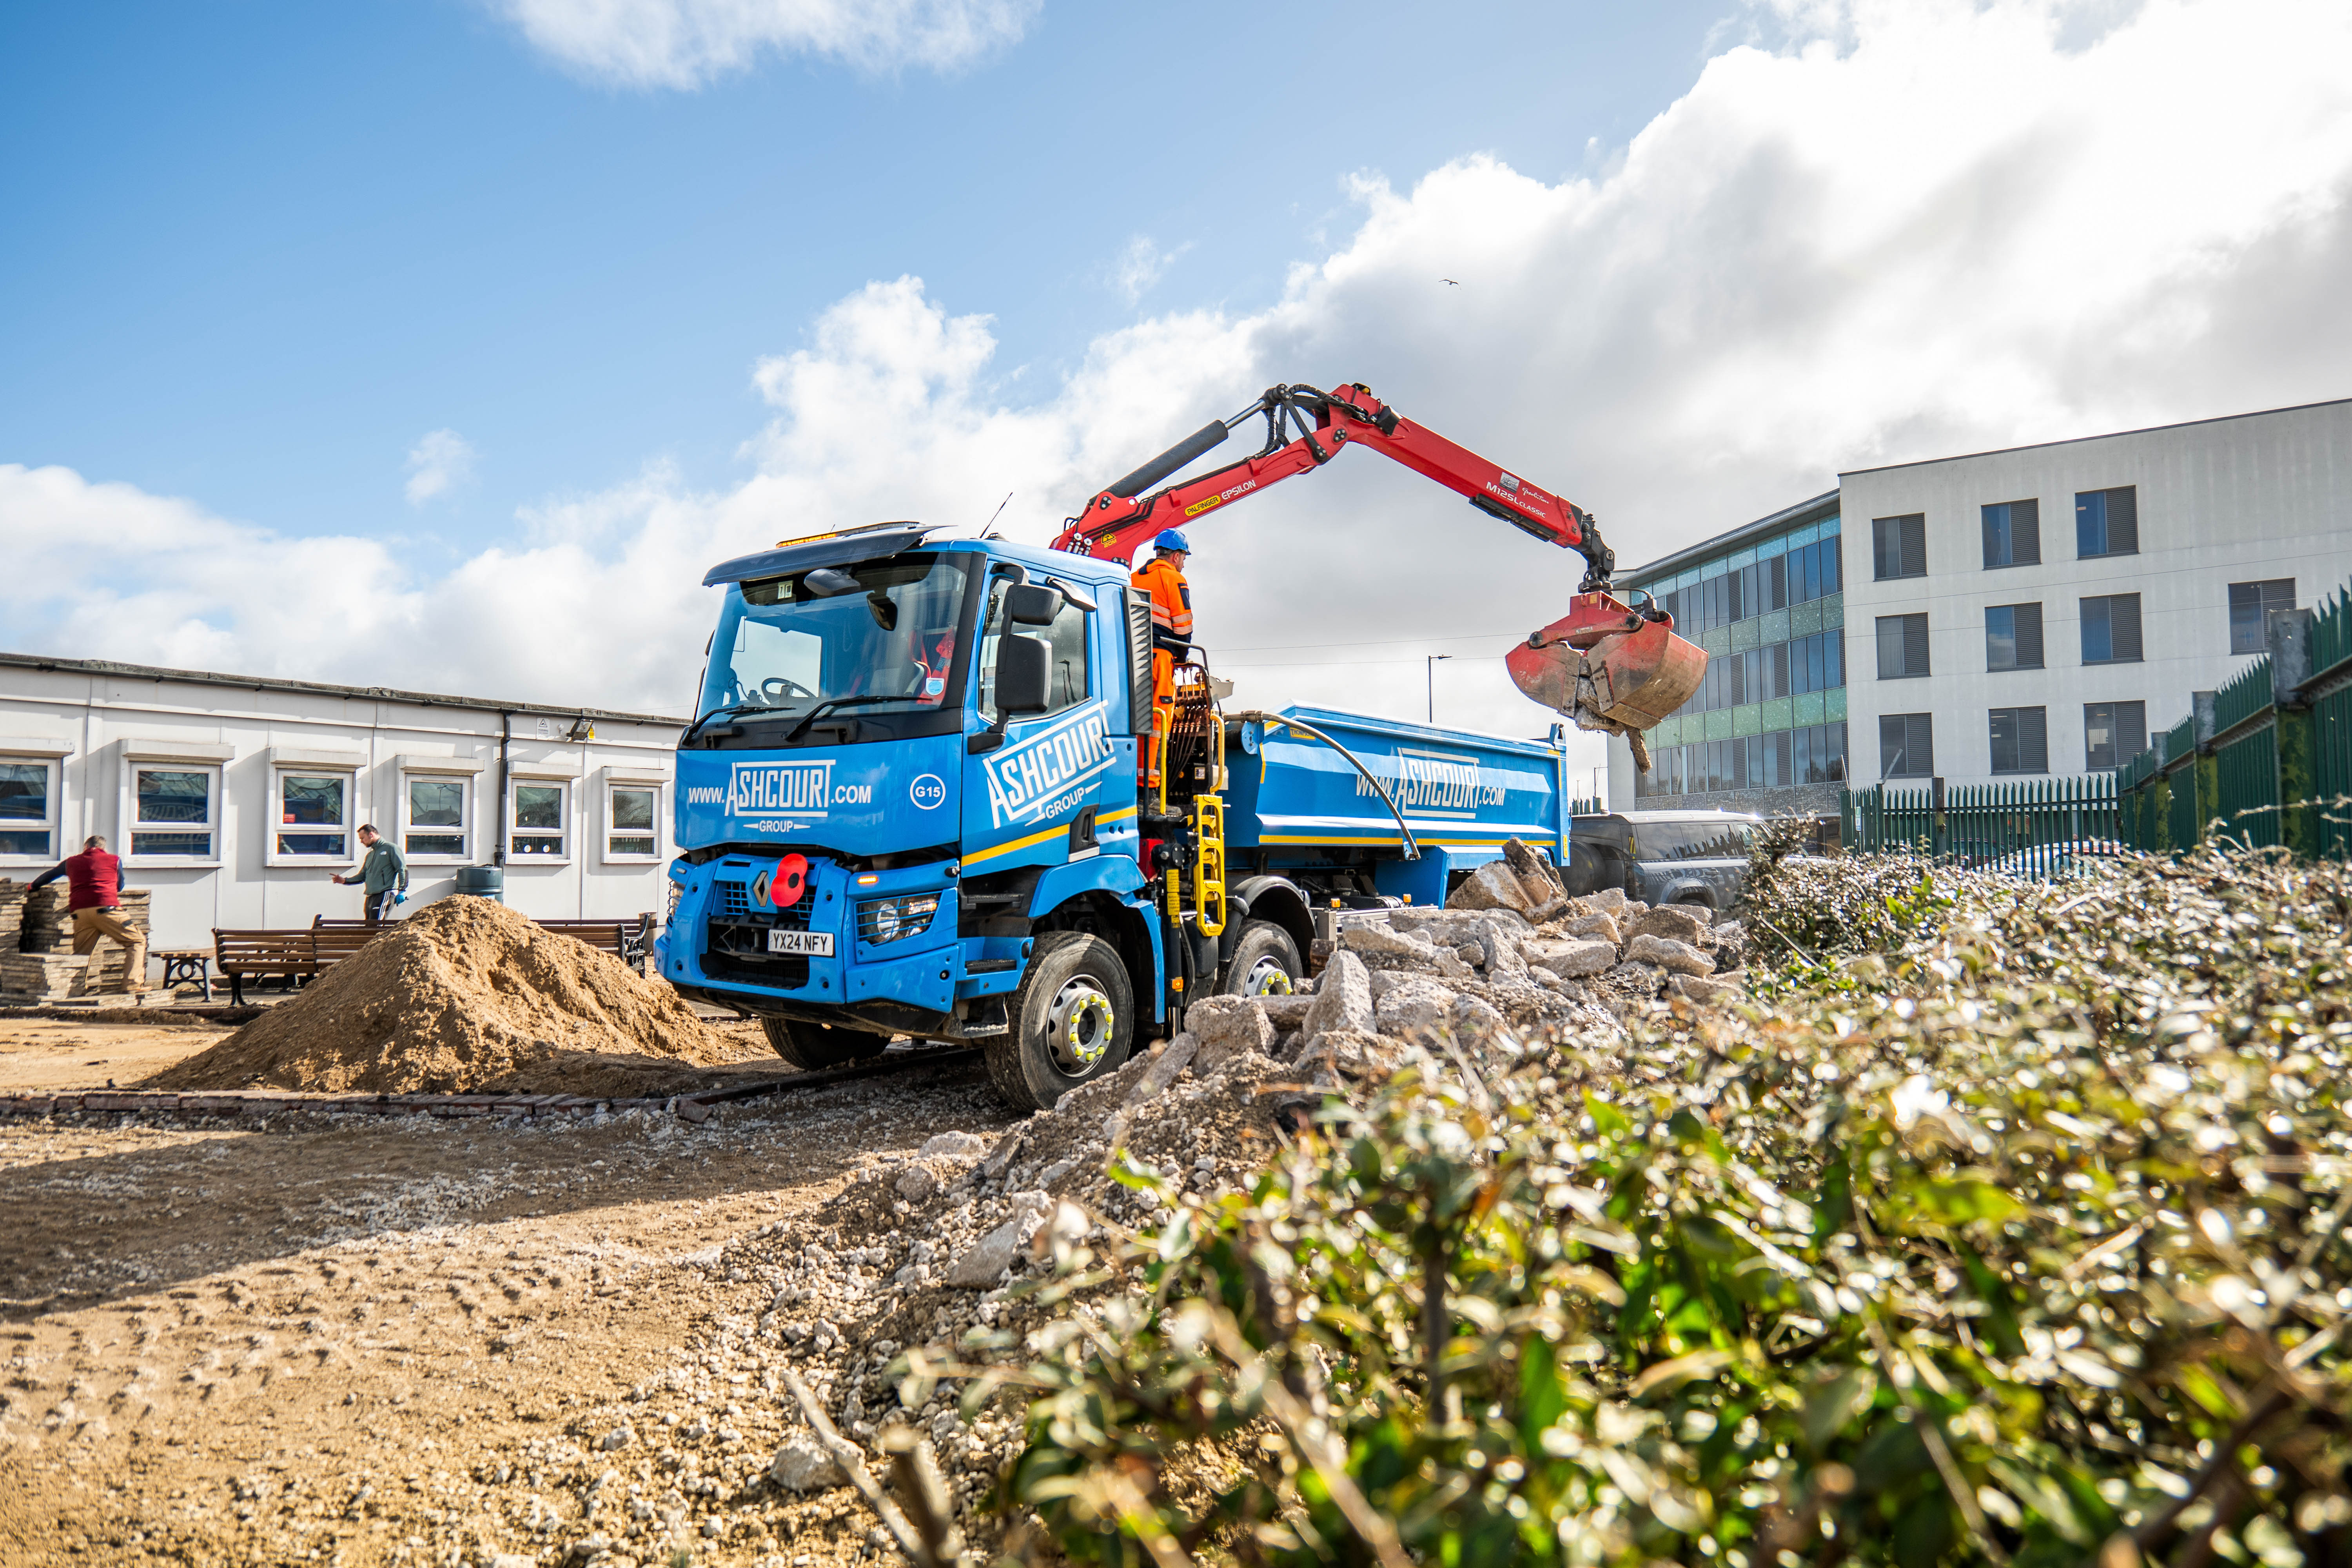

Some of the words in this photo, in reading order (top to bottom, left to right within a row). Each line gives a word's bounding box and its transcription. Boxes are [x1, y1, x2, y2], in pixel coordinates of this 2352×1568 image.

[1187, 497, 1219, 514] PALFINGER
[1221, 479, 1256, 500] EPSILON
[1486, 481, 1519, 505] M125L
[1519, 501, 1546, 518] CLASSIC
[1103, 539, 1117, 548] 20M
[982, 699, 1117, 829] ASHCOURT
[915, 786, 941, 798] G15
[1045, 787, 1085, 819] GROUP
[759, 820, 793, 833] GROUP
[773, 933, 801, 950] YX24
[804, 935, 828, 952] NFY
